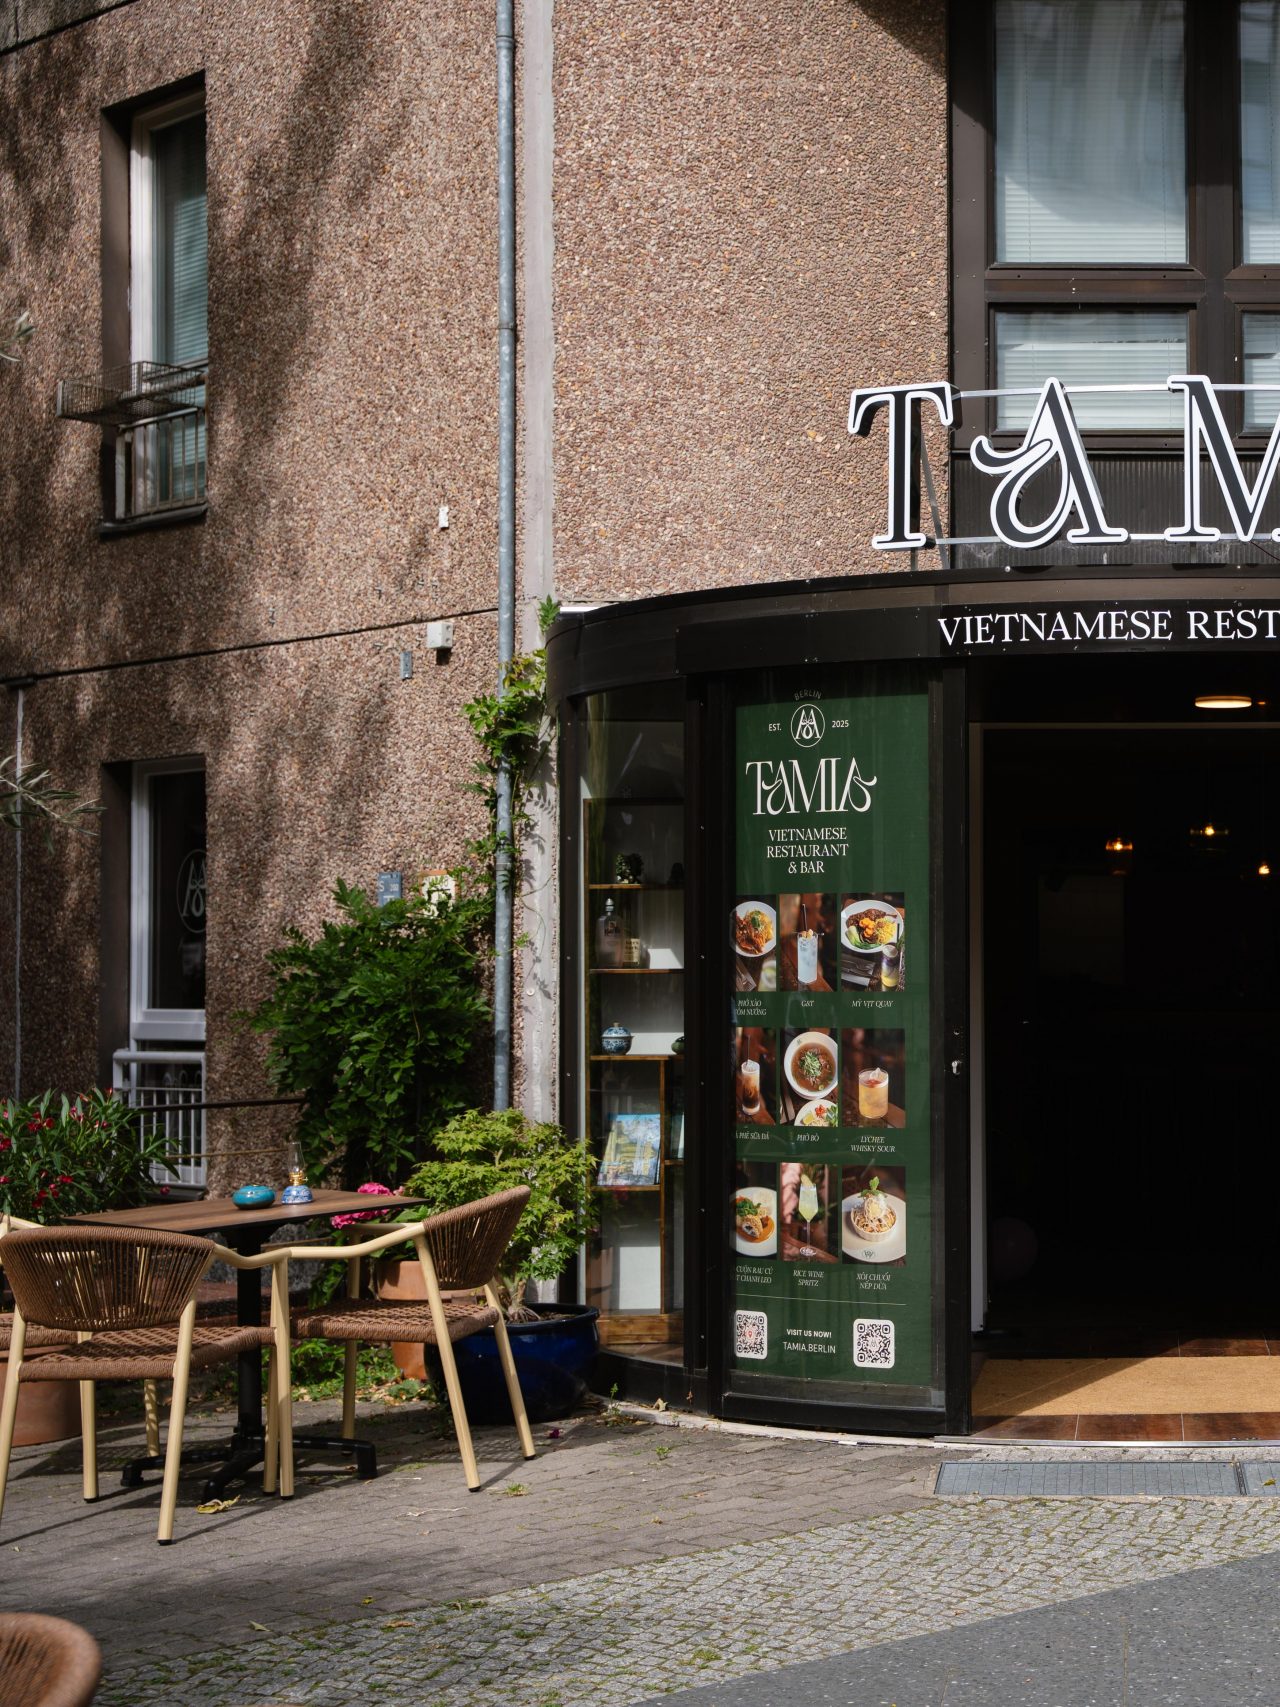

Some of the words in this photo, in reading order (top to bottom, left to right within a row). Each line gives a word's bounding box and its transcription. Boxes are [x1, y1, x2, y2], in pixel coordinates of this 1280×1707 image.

[938, 609, 1173, 647] VIETNAMESE
[794, 688, 822, 701] BERLIN
[768, 723, 782, 732] EST.
[831, 720, 850, 729] 2025
[745, 756, 877, 816] TAMIA
[768, 827, 848, 842] VIETNAMESE
[767, 843, 849, 859] RESTAURANT
[788, 861, 797, 874] &
[800, 861, 825, 874] BAR
[877, 1145, 896, 1153] SOUR
[808, 1270, 824, 1278] WINE
[786, 1329, 802, 1337] VISIT
[813, 1330, 832, 1338] NOW!
[782, 1341, 836, 1354] TAMIA.BERLIN
